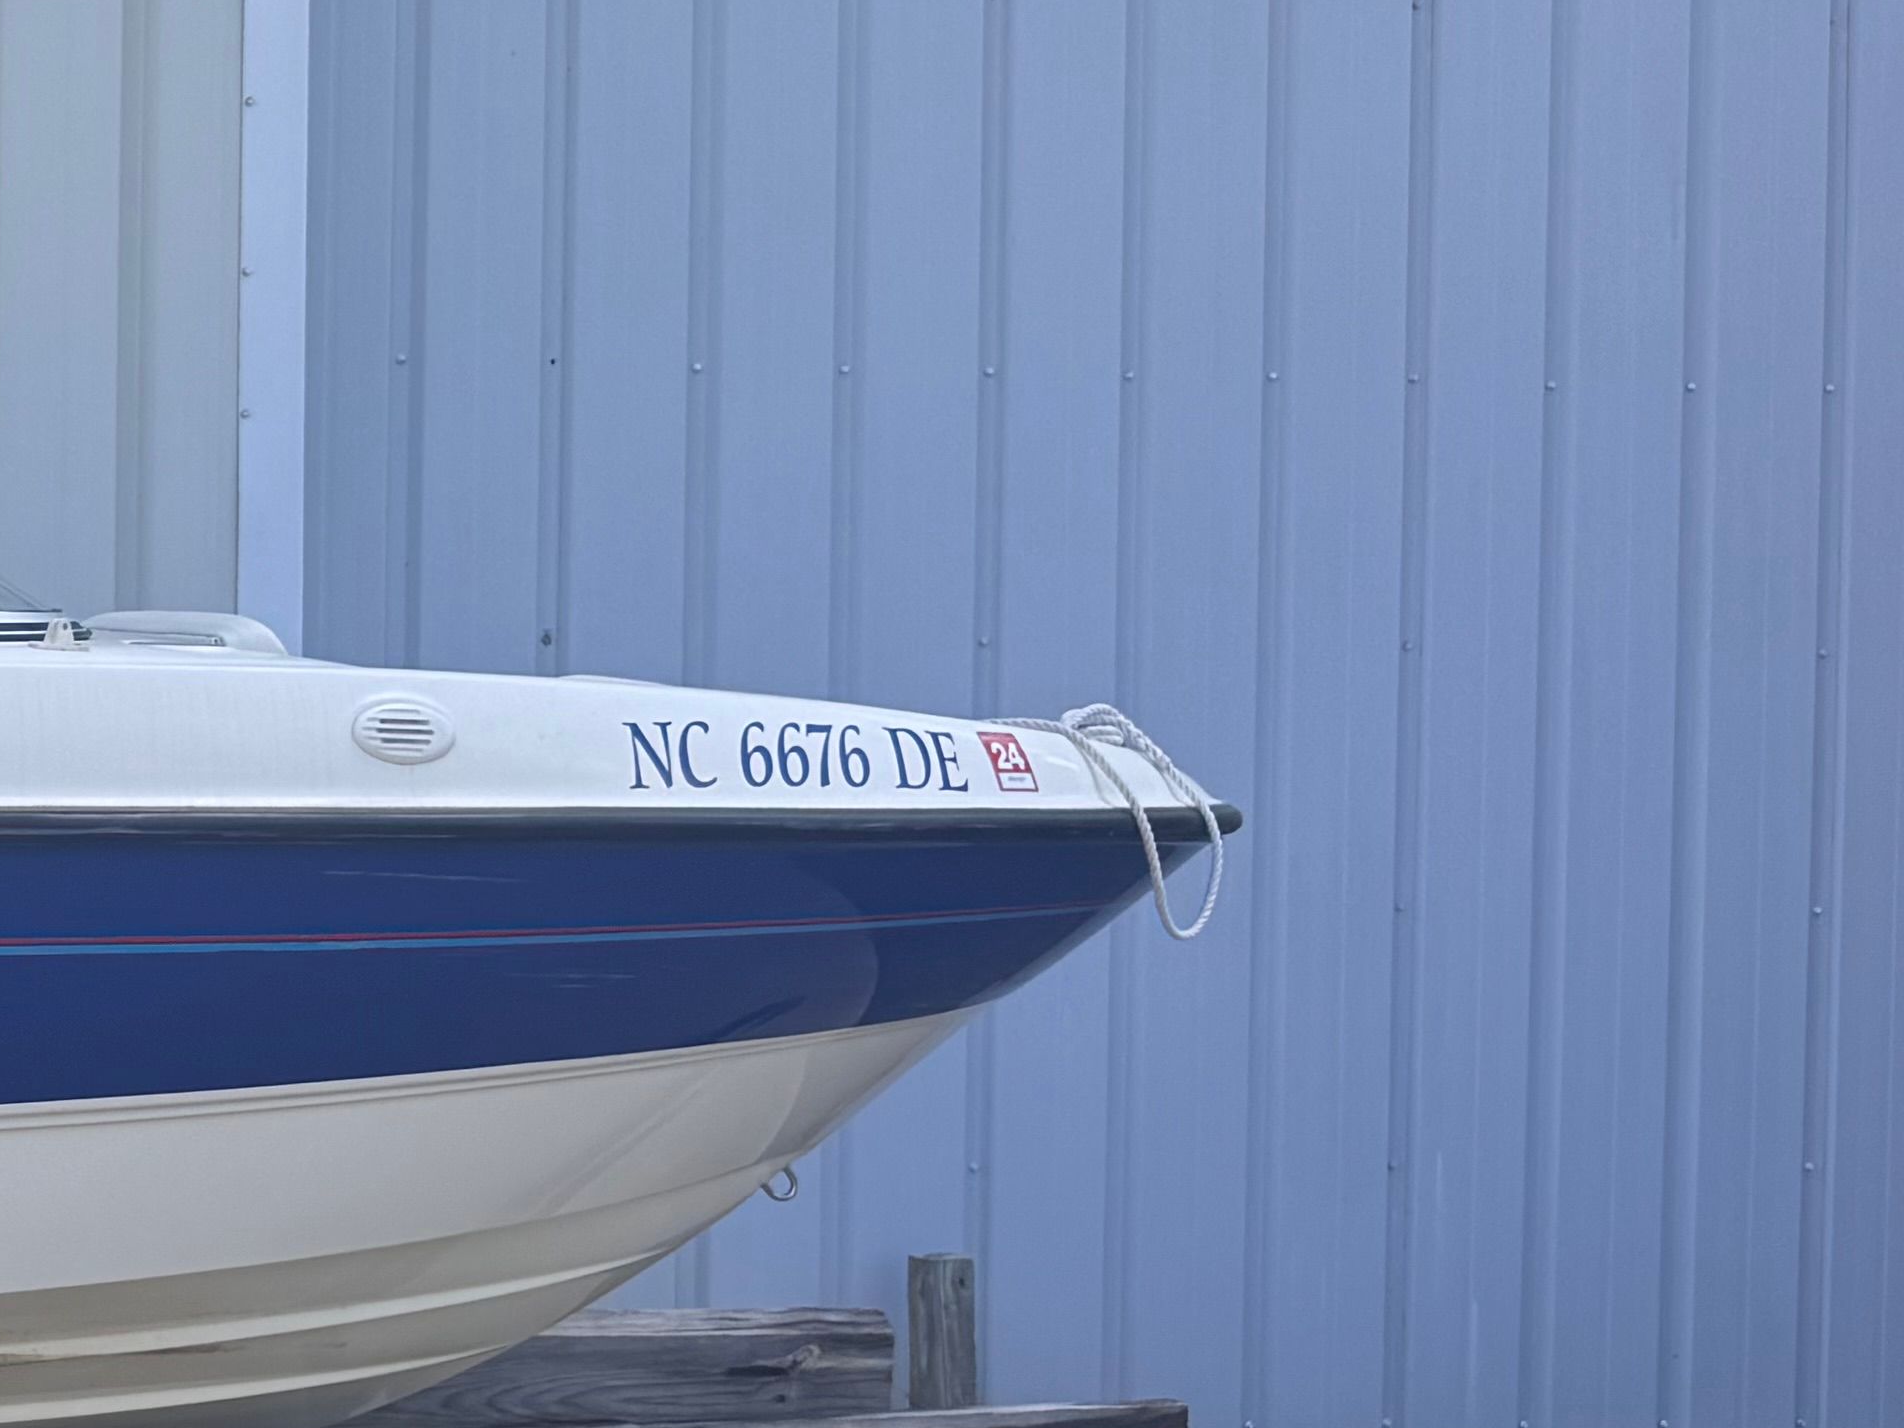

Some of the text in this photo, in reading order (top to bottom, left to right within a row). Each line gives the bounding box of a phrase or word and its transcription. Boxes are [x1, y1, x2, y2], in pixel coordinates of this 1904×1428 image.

[622, 720, 969, 792] NC 6676 DE
[990, 741, 1026, 771] 24
